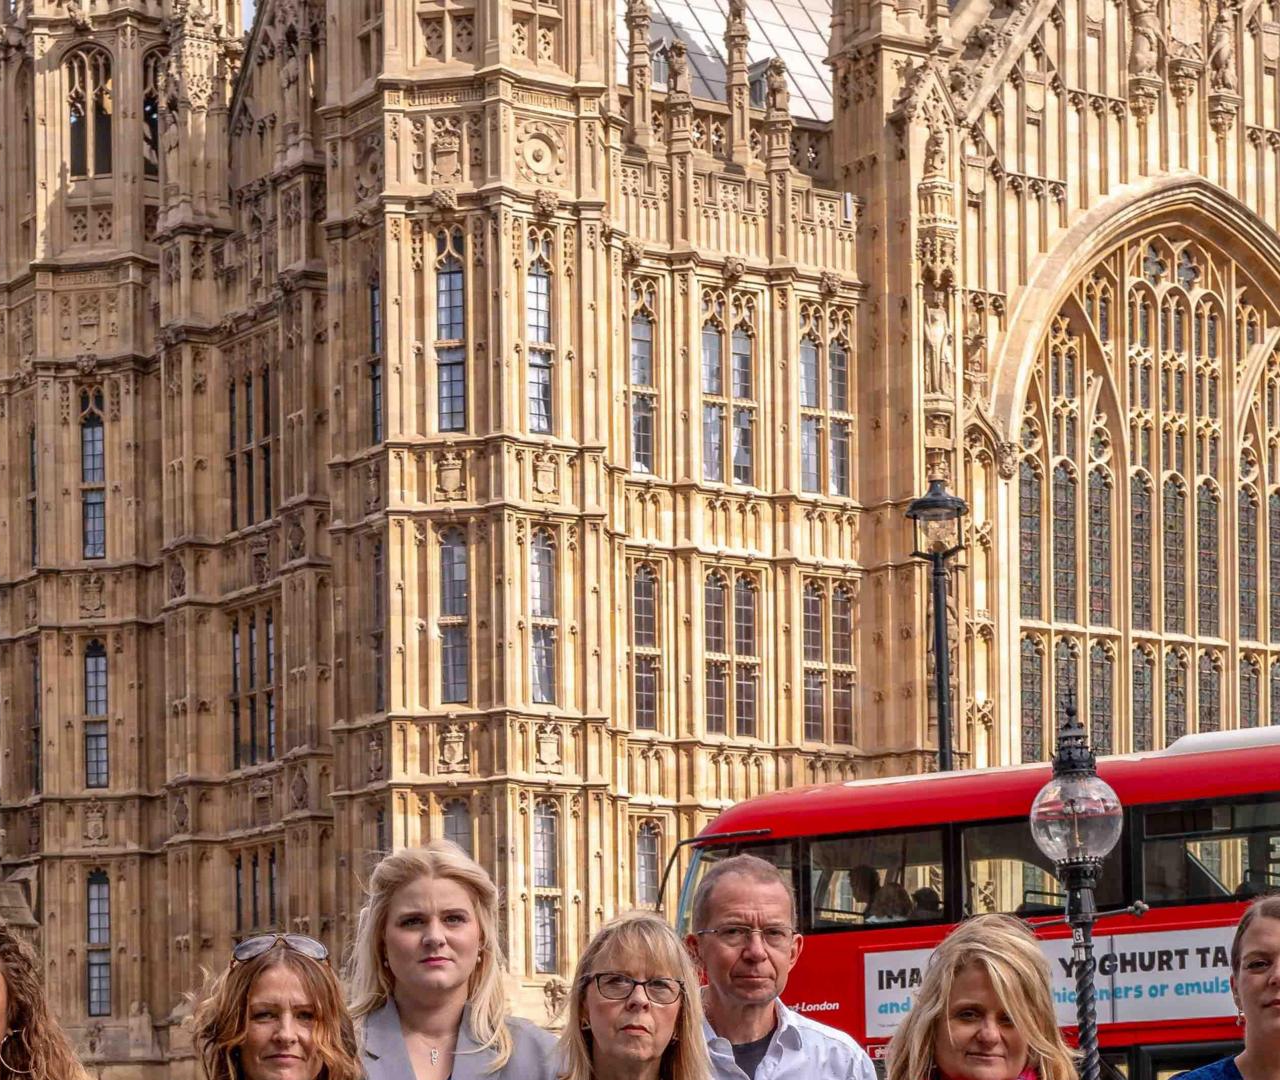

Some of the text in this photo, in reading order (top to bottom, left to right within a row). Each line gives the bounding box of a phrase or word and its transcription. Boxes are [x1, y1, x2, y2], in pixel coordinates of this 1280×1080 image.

[1196, 946, 1230, 968] TA
[878, 996, 911, 1014] and
[1148, 982, 1168, 998] or
[1173, 976, 1230, 996] emuls
